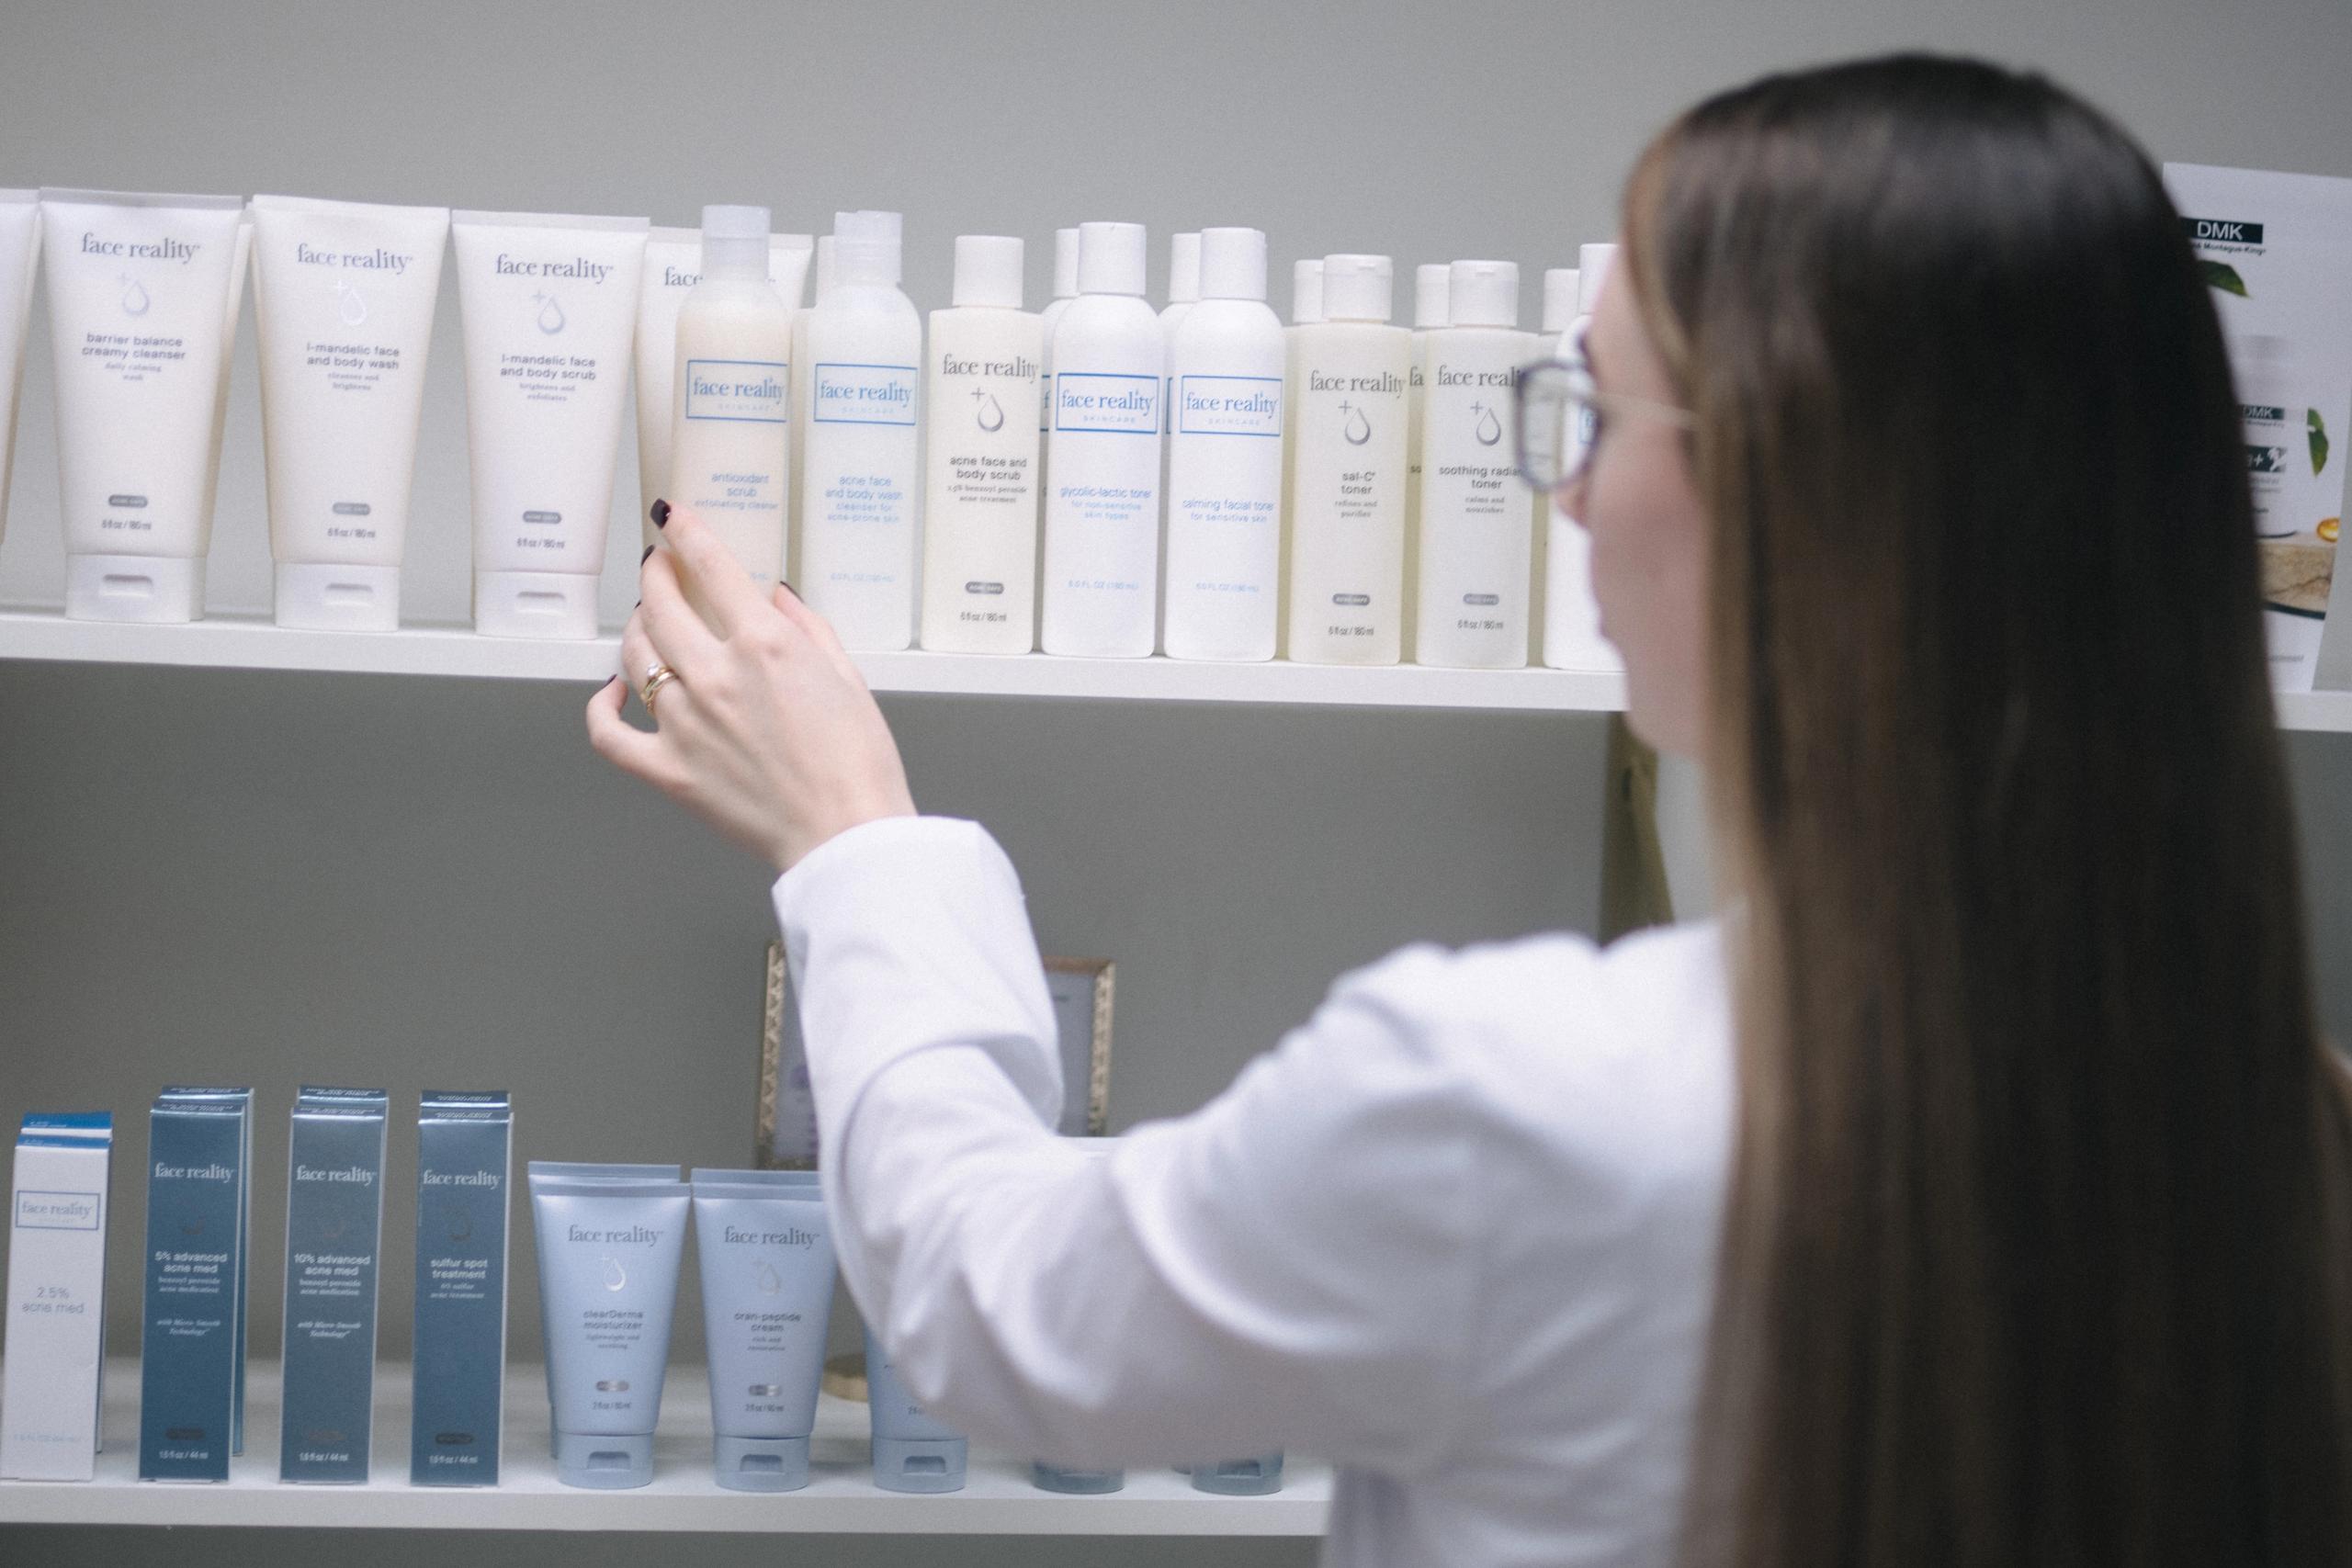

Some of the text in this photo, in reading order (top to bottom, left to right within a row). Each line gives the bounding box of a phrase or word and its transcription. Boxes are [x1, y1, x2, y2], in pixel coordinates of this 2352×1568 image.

[2197, 220, 2244, 241] DMK
[82, 231, 197, 265] face reality
[298, 243, 409, 275] face reality
[496, 254, 608, 285] face reality
[86, 332, 183, 346] barrier balance
[81, 345, 187, 360] creamy cleanser
[374, 345, 400, 356] face
[307, 355, 400, 369] and body wash
[571, 355, 595, 367] face
[500, 367, 597, 380] and body scrub
[943, 353, 1038, 384] face reality
[1438, 365, 1474, 386] face
[694, 376, 784, 405] face reality
[1310, 369, 1406, 399] face reality
[820, 379, 912, 408] face reality
[1061, 389, 1093, 408] face
[1099, 389, 1154, 416] reality
[1187, 390, 1278, 419] face reality
[949, 456, 1027, 468] acne face and
[956, 468, 1022, 481] body scrub
[1439, 466, 1487, 479] soothing
[839, 476, 892, 487] acne face
[1471, 479, 1503, 490] toner
[727, 488, 757, 497] scrub
[825, 490, 844, 498] and
[846, 490, 875, 502] body
[1340, 485, 1373, 495] toner
[154, 1162, 233, 1183] face reality
[296, 1165, 376, 1186] face reality
[424, 1169, 501, 1190] face reality
[22, 1201, 92, 1219] face reality
[569, 1224, 659, 1247] face reality
[724, 1225, 817, 1249] face reality
[174, 1251, 229, 1262] advanced
[294, 1253, 370, 1265] 10% advanced
[164, 1263, 219, 1273] acne med
[305, 1266, 359, 1276] acne med
[432, 1269, 486, 1279] treatment
[22, 1303, 85, 1314] acne med
[751, 1325, 784, 1333] cream
